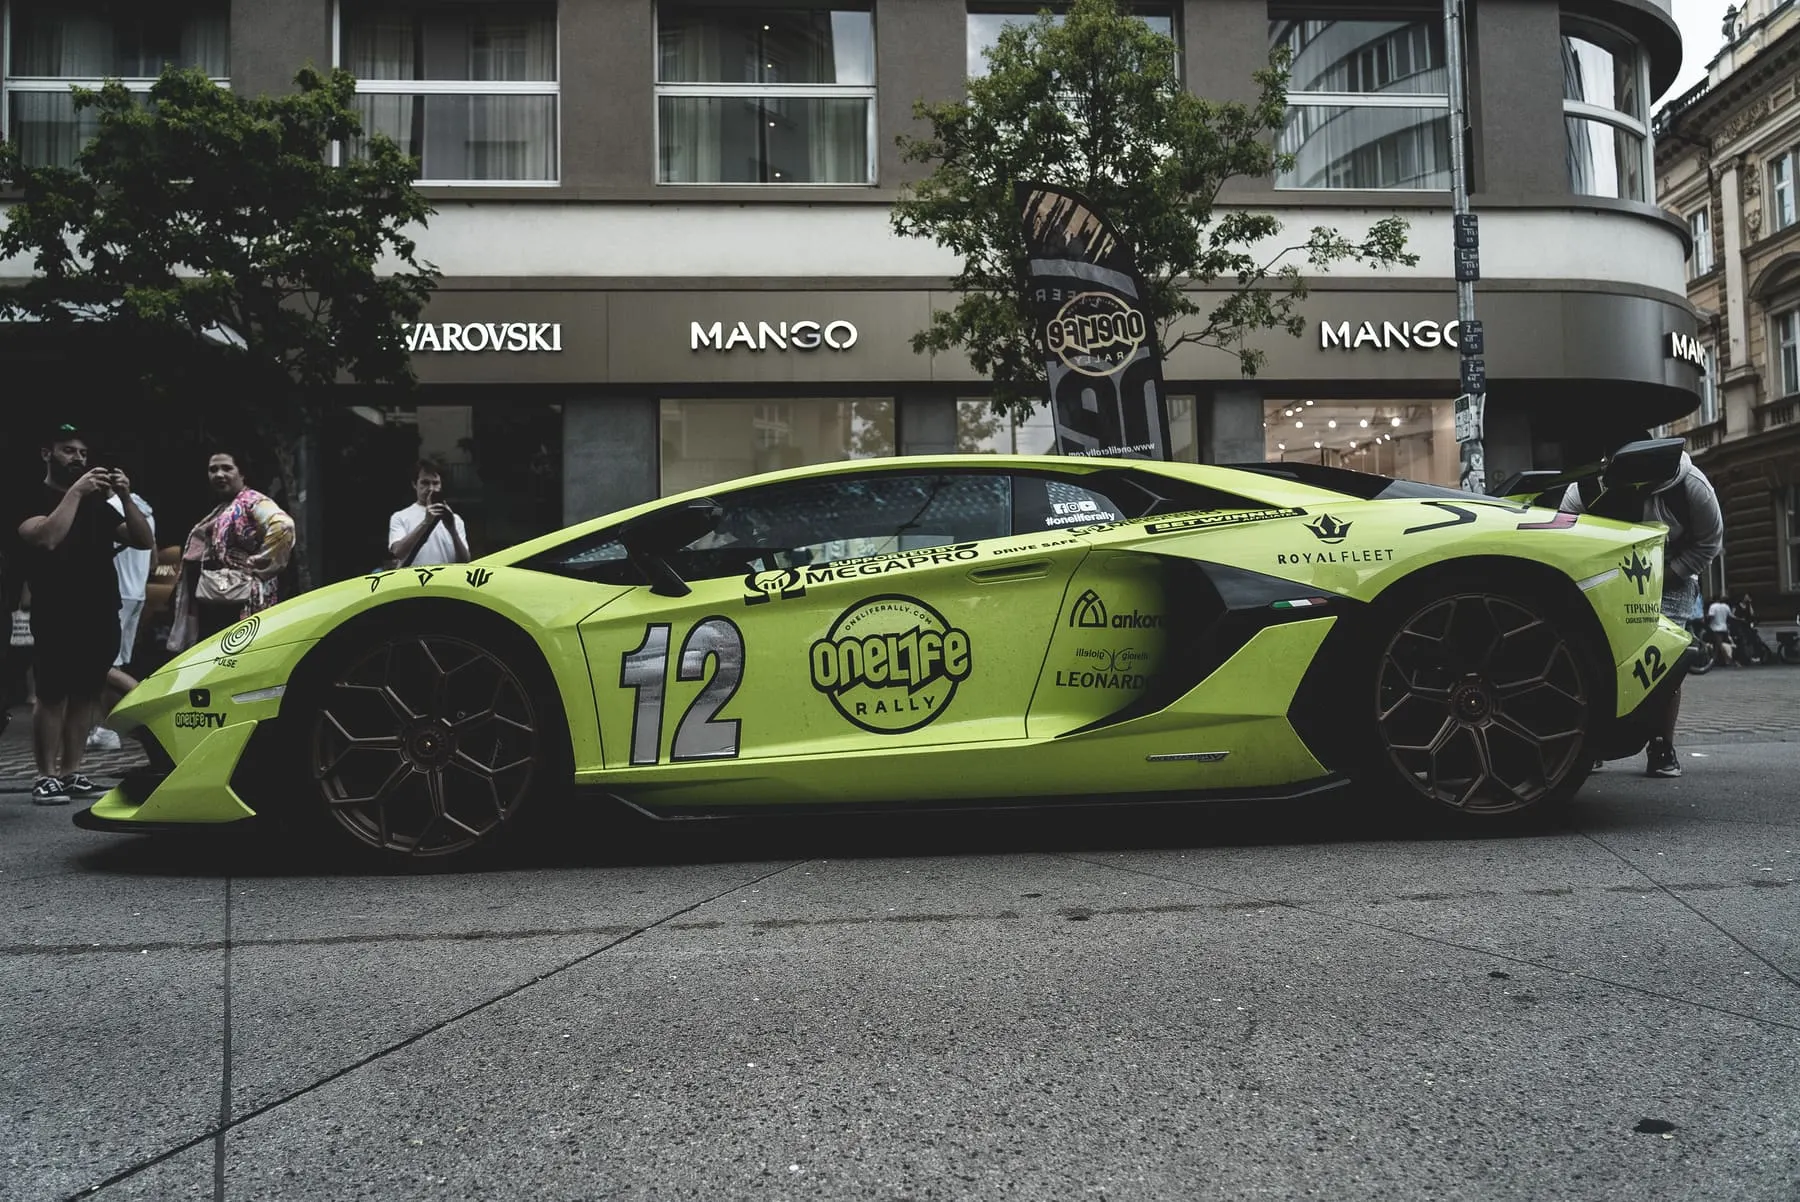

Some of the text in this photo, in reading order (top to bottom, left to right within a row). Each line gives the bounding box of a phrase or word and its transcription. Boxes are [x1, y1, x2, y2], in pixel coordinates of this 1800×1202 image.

[402, 322, 562, 352] AROVSKI
[691, 320, 859, 350] MANGO
[1671, 331, 1706, 368] MAN
[1046, 512, 1115, 527] #oneliferally
[829, 547, 937, 568] SUPPORTED
[939, 545, 959, 555] BY
[993, 538, 1079, 556] DRIVE SAFE
[806, 549, 979, 585] MEGAPRO
[844, 604, 932, 631] ONELIFERALLY.COM
[1624, 603, 1660, 614] TIPKING
[213, 656, 238, 669] PULSE
[1632, 644, 1668, 690] 12
[619, 614, 746, 766] 12
[856, 695, 935, 716] RALLY
